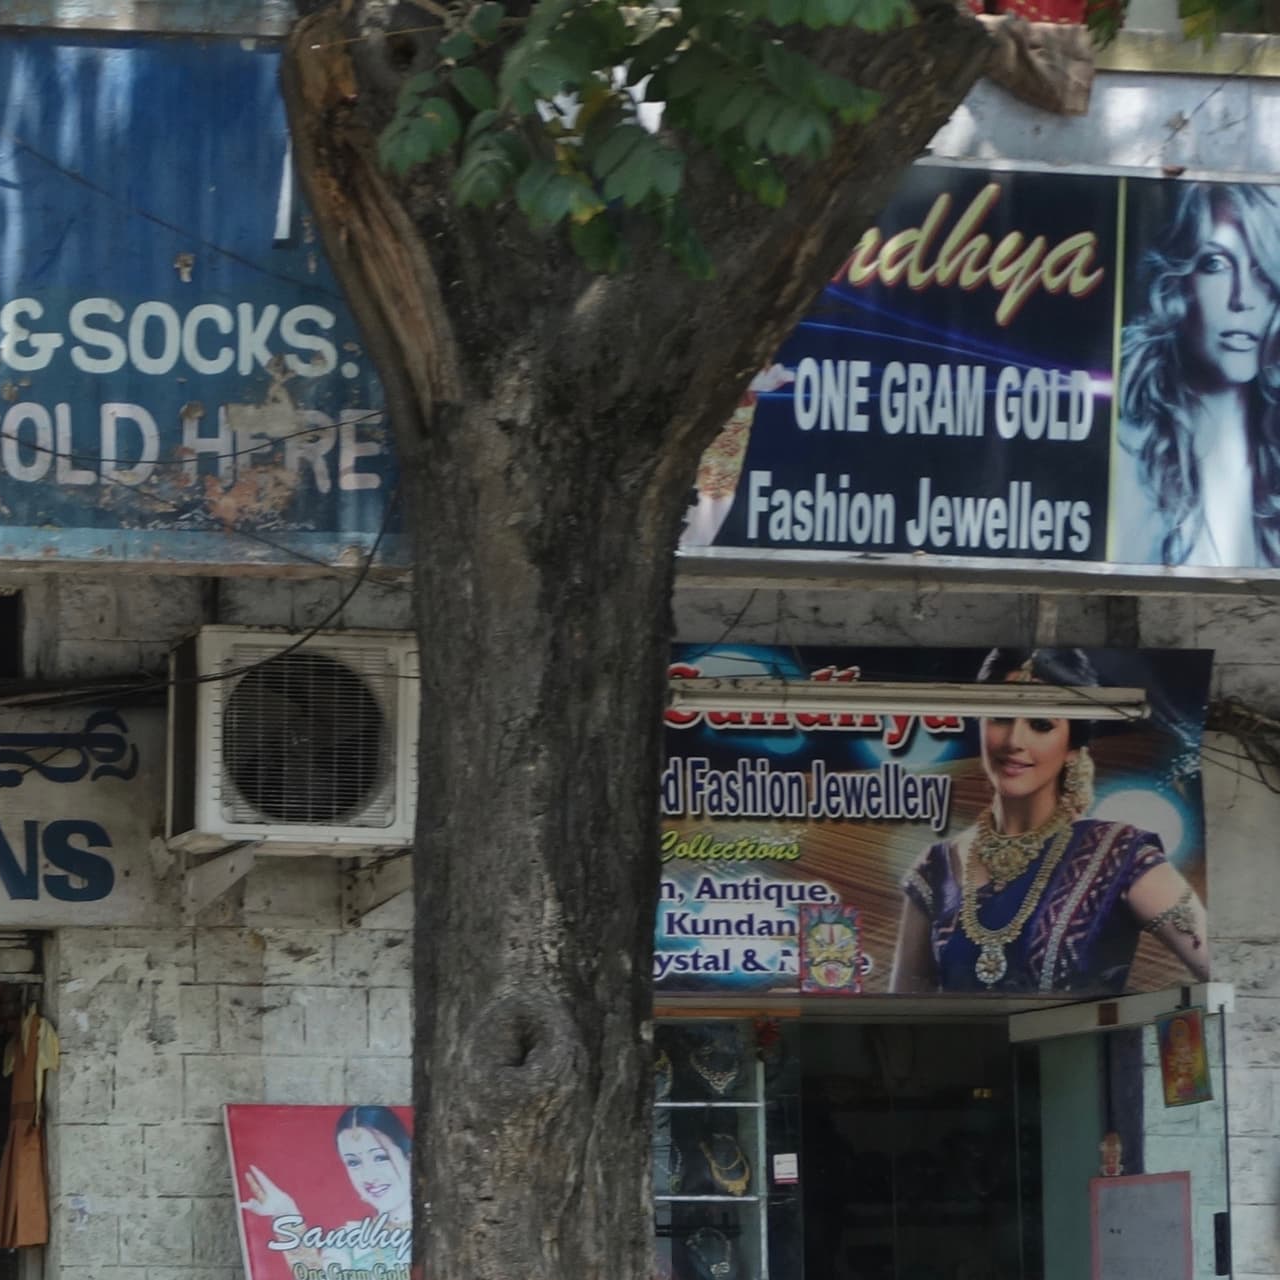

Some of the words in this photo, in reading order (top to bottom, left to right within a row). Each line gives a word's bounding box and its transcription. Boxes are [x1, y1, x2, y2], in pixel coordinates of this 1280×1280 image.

[793, 356, 872, 433] ONE
[880, 360, 985, 438] GRAM
[995, 367, 1094, 442] GOLD
[746, 470, 895, 545] Fashion
[905, 476, 1092, 553] Jewellers
[689, 757, 806, 817] Fashion
[810, 759, 954, 832] Jewellery
[666, 911, 797, 937] Kundan
[693, 877, 838, 909] Antique,
